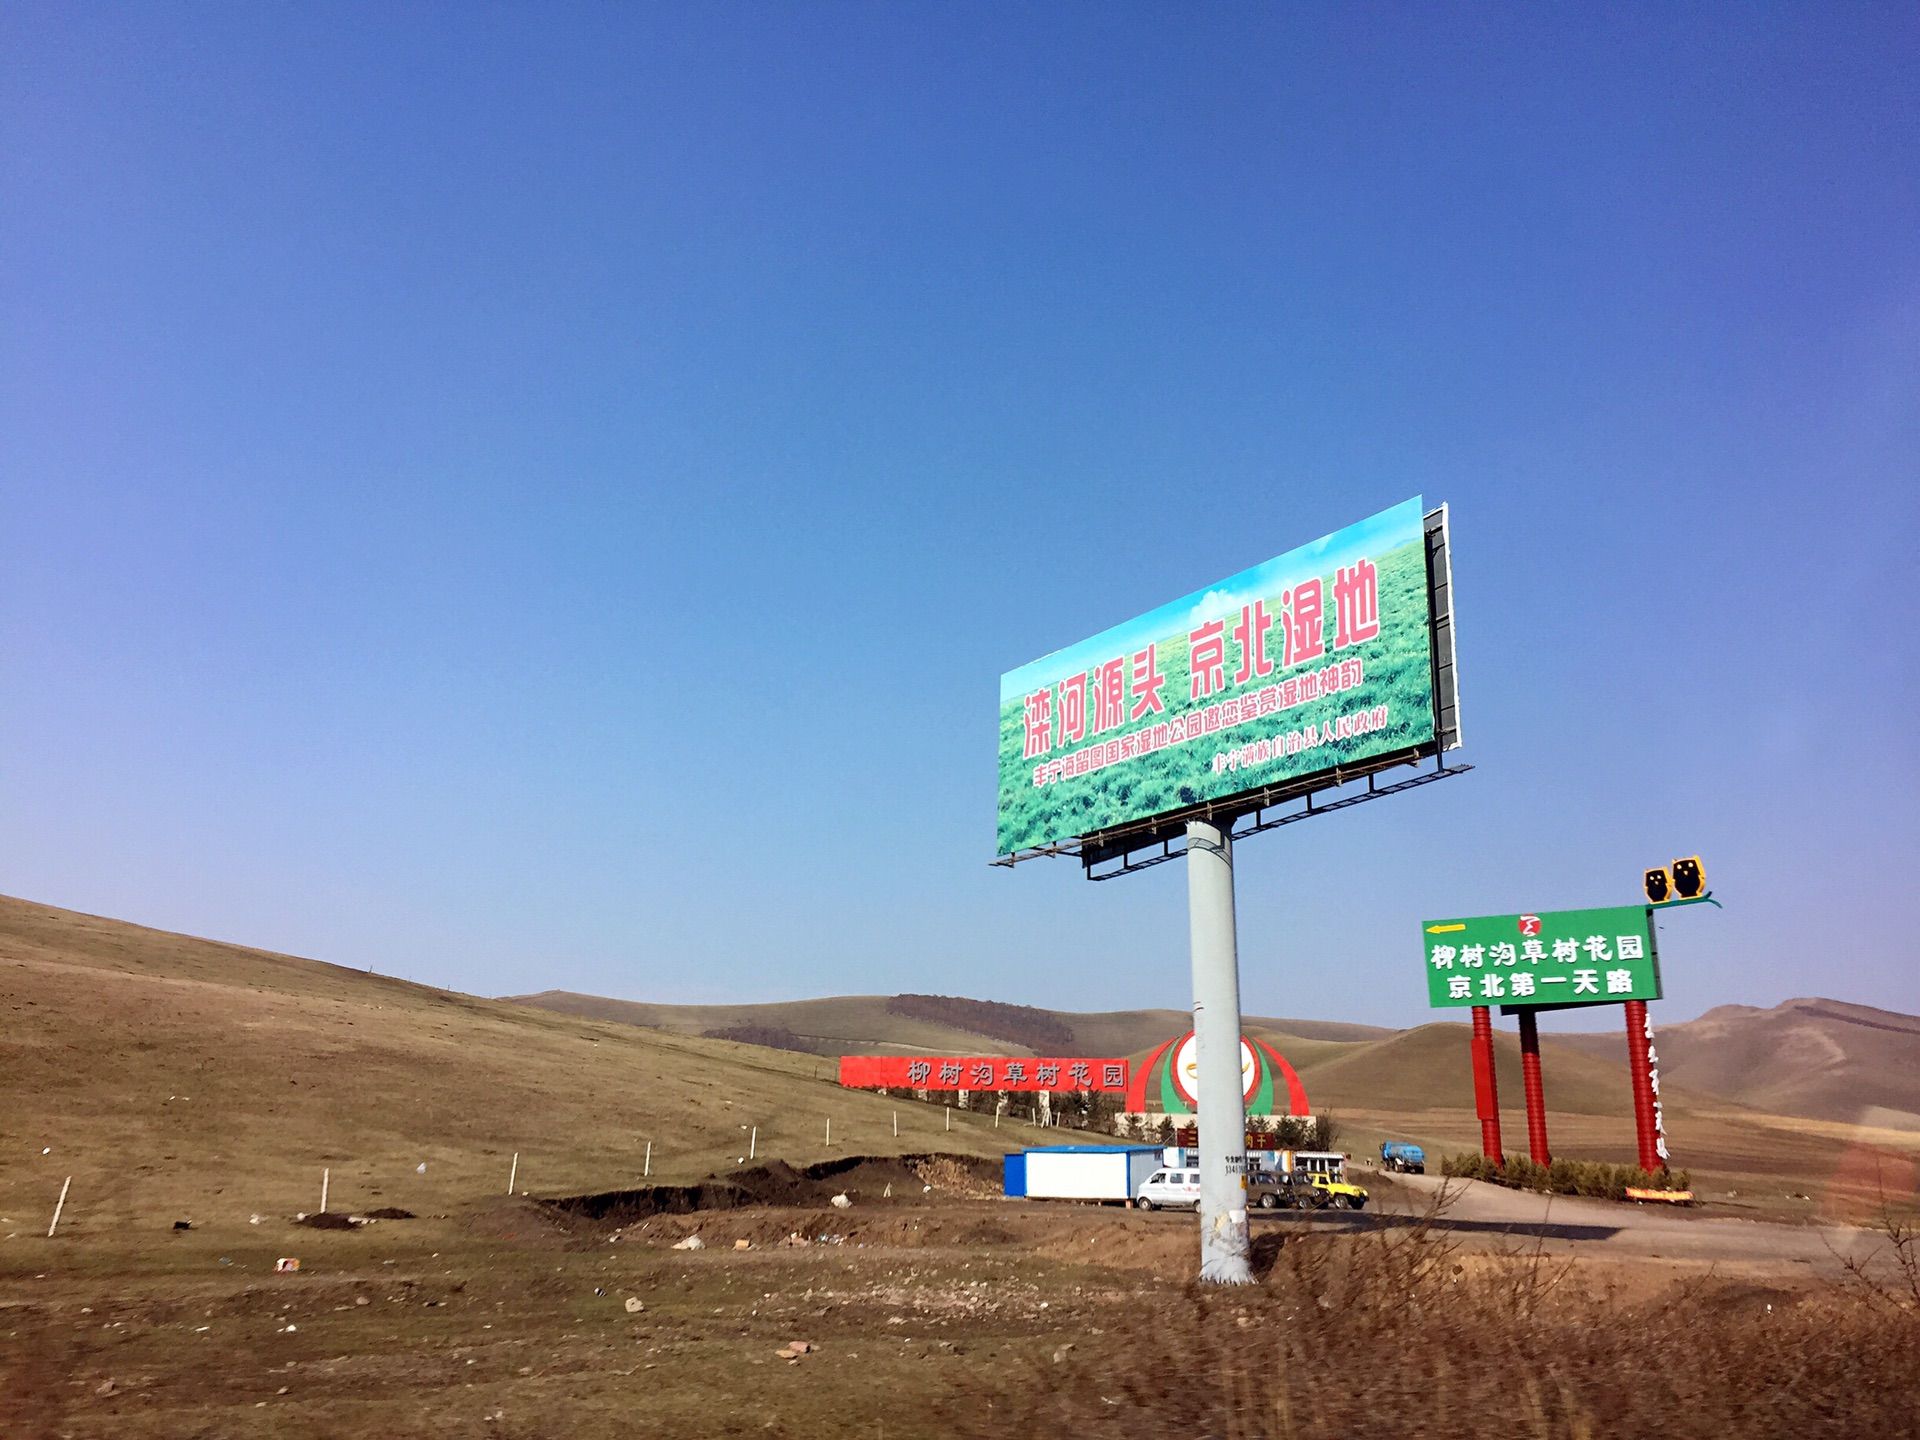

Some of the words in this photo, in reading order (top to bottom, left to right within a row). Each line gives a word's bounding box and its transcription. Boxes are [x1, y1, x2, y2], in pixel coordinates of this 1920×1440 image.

[1023, 644, 1165, 758] 滦河源头
[1189, 559, 1380, 699] 京北湿地
[1033, 658, 1363, 787] 丰宁海留图国家湿地公园邀您鉴赏湿地神韵
[1213, 704, 1388, 774] 丰宁满族自治县人民政府
[1430, 935, 1644, 970] 柳树沟草树花园
[1447, 969, 1634, 999] 京北第一天路
[907, 1060, 1125, 1088] 柳树沟草树花园
